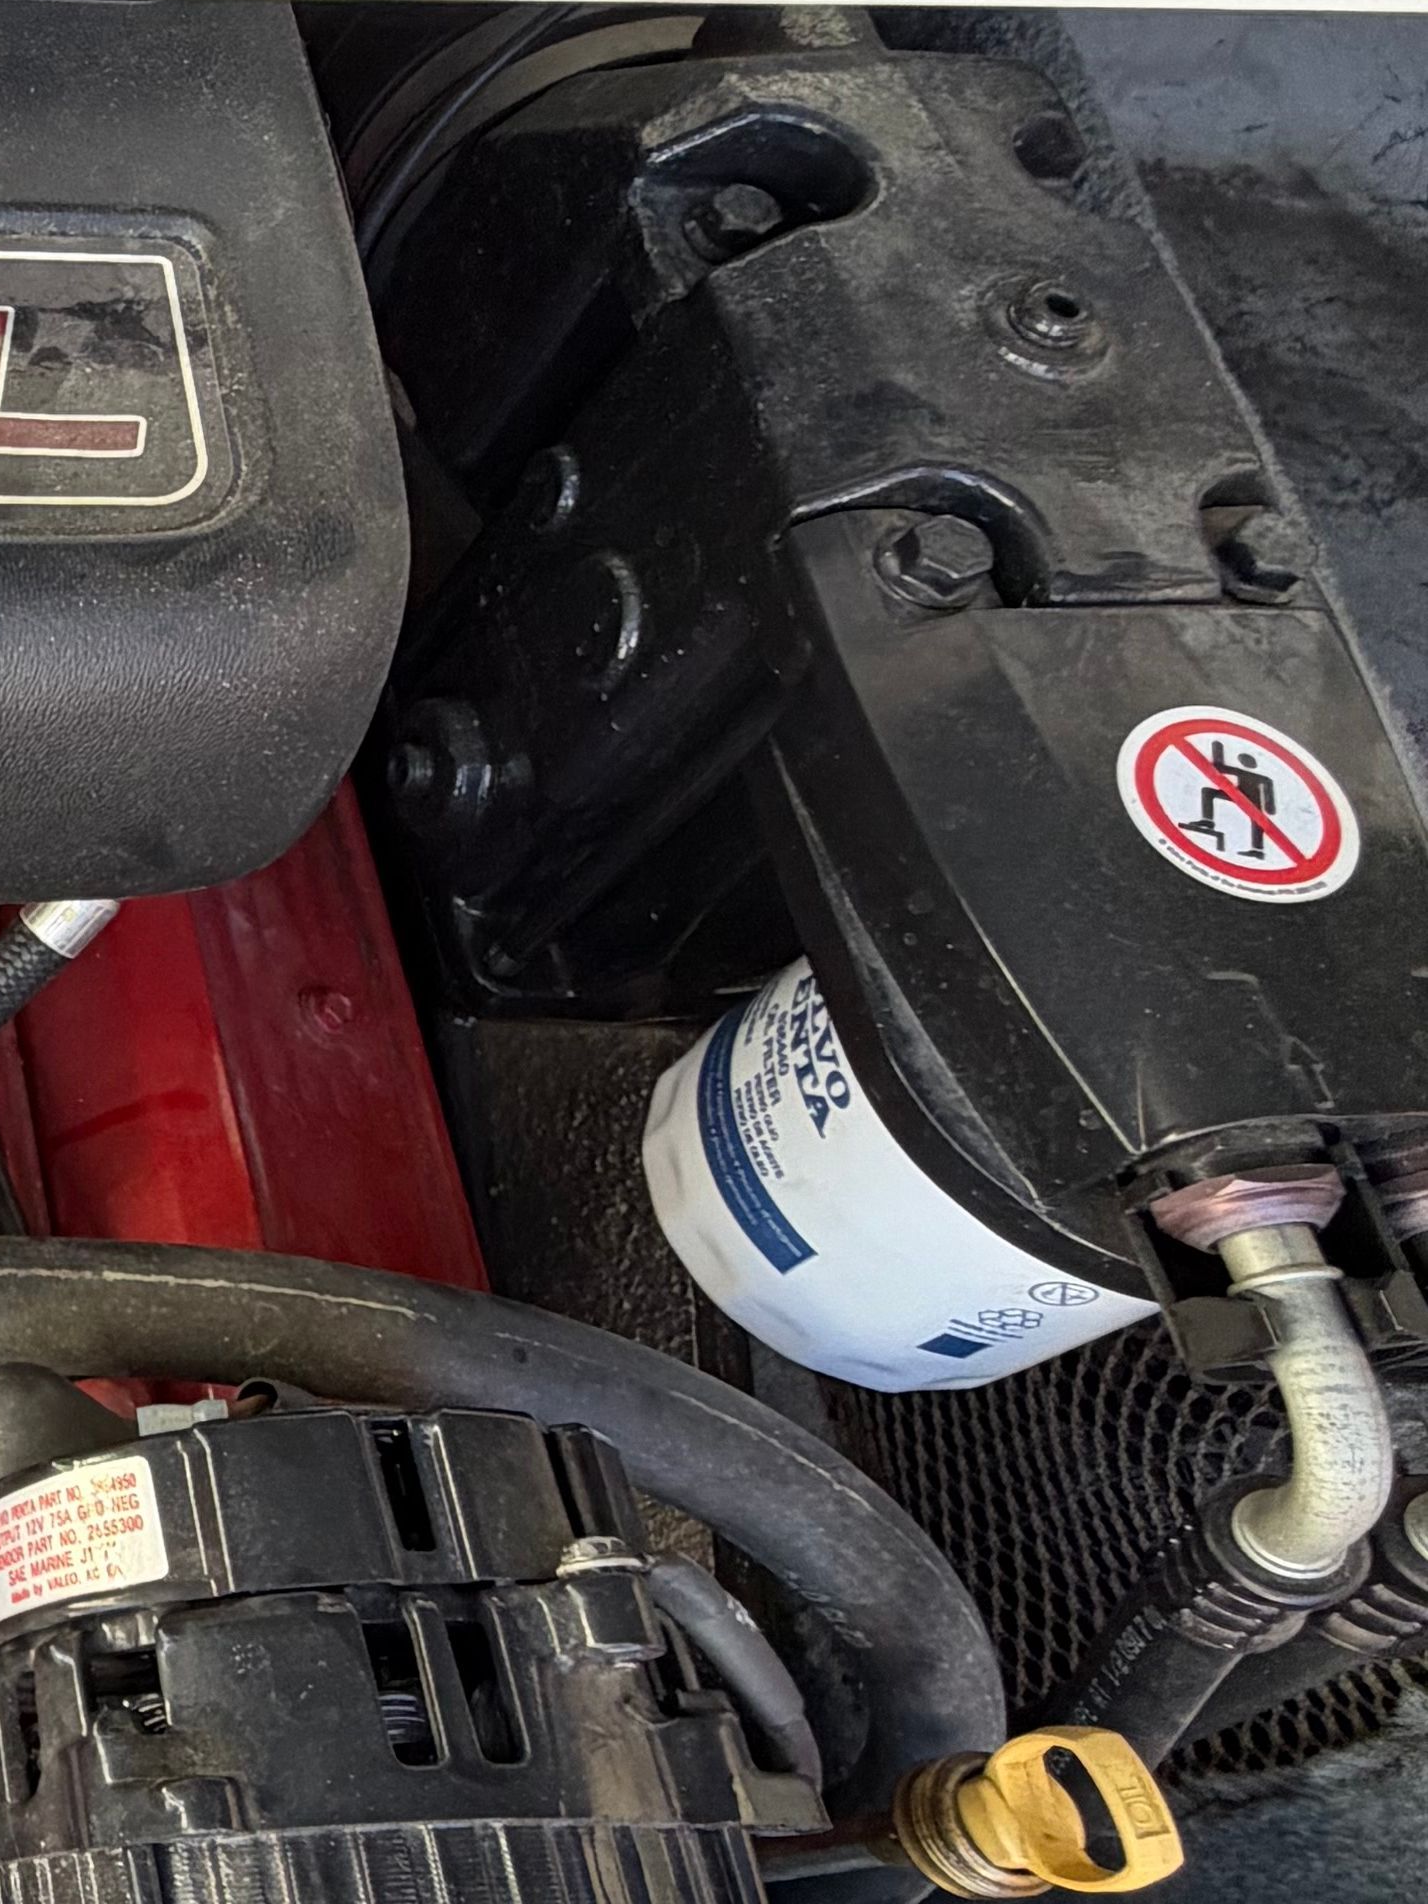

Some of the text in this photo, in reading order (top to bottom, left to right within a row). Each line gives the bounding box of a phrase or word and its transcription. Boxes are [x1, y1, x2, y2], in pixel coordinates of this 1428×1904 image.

[39, 1490, 62, 1510] PART
[25, 1517, 45, 1538] 12V
[28, 1536, 53, 1559] PART
[8, 1566, 27, 1587] SAE
[30, 1551, 73, 1578] MARINE
